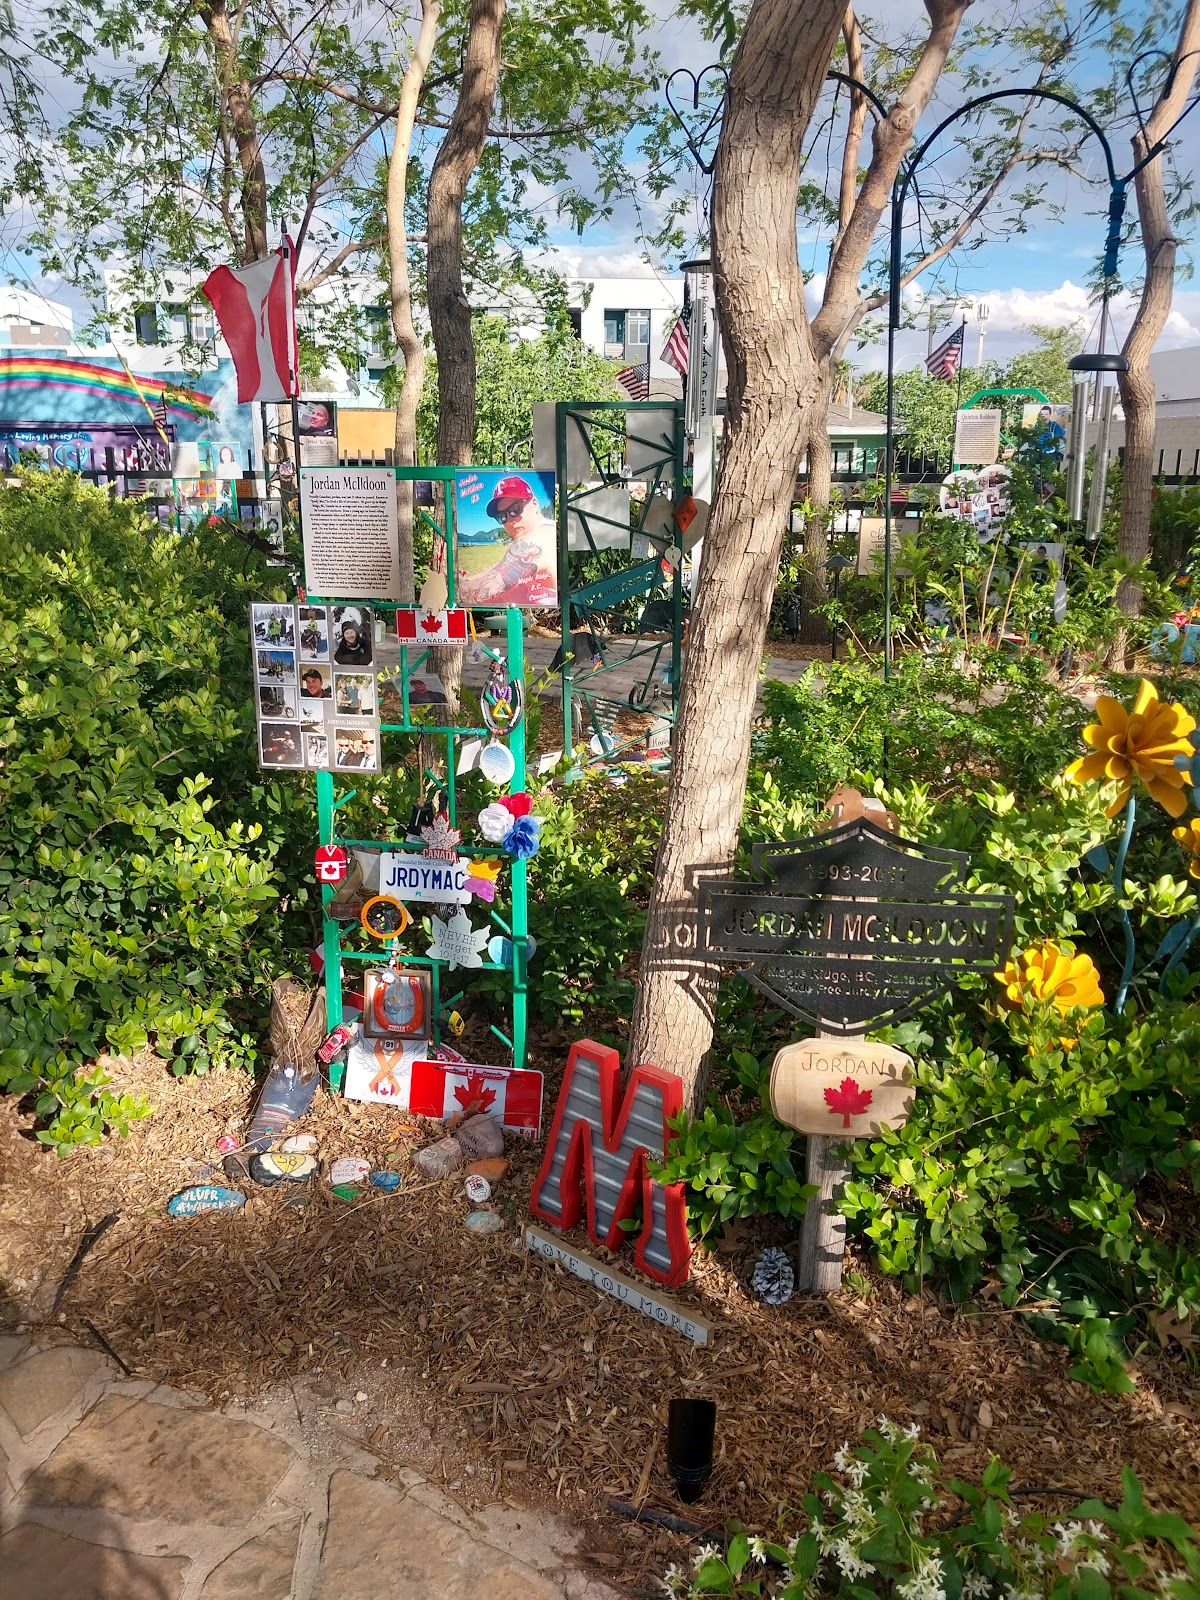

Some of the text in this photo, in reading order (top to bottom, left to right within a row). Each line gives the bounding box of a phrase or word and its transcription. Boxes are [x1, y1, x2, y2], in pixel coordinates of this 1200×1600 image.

[15, 431, 41, 441] Loving
[42, 433, 73, 441] Memory
[310, 475, 387, 494] Jordan McIldoon
[423, 849, 462, 864] CANADA
[386, 867, 466, 890] JRDYMAC
[722, 907, 988, 949] JORDAN MCILDOON
[438, 929, 477, 947] NEVER
[440, 939, 472, 955] forget
[440, 950, 470, 964] 10-1-17
[810, 968, 851, 984] Ridge,
[854, 970, 879, 985] BC,
[816, 983, 843, 996] Free
[801, 1051, 887, 1077] JORDAN
[277, 1154, 299, 1168] 58
[530, 1233, 697, 1339] LOVE YOU MORE
